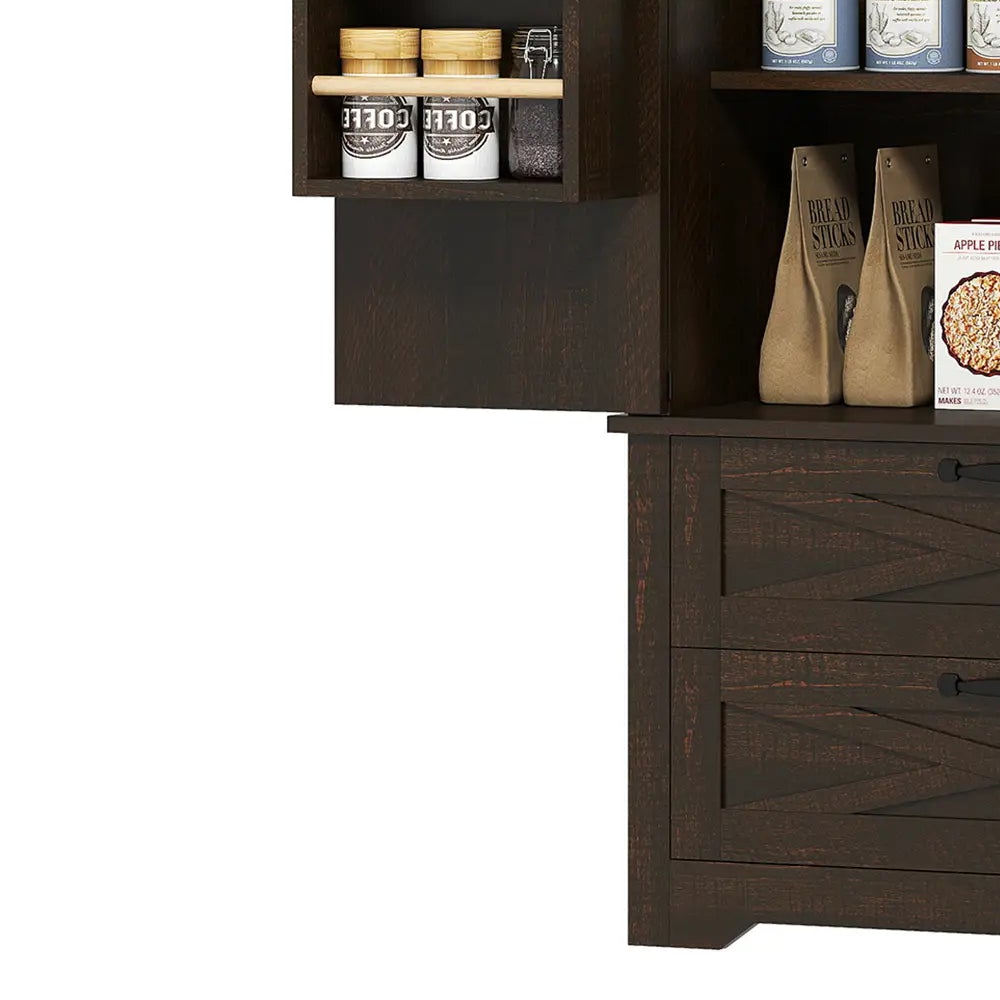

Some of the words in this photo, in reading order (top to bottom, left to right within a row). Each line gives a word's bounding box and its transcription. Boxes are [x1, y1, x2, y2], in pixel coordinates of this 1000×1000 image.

[807, 197, 850, 224] BREAD
[891, 198, 934, 225] BREAD
[811, 221, 856, 250] STICKS
[954, 239, 985, 251] APPLE
[938, 397, 962, 405] MAKES
